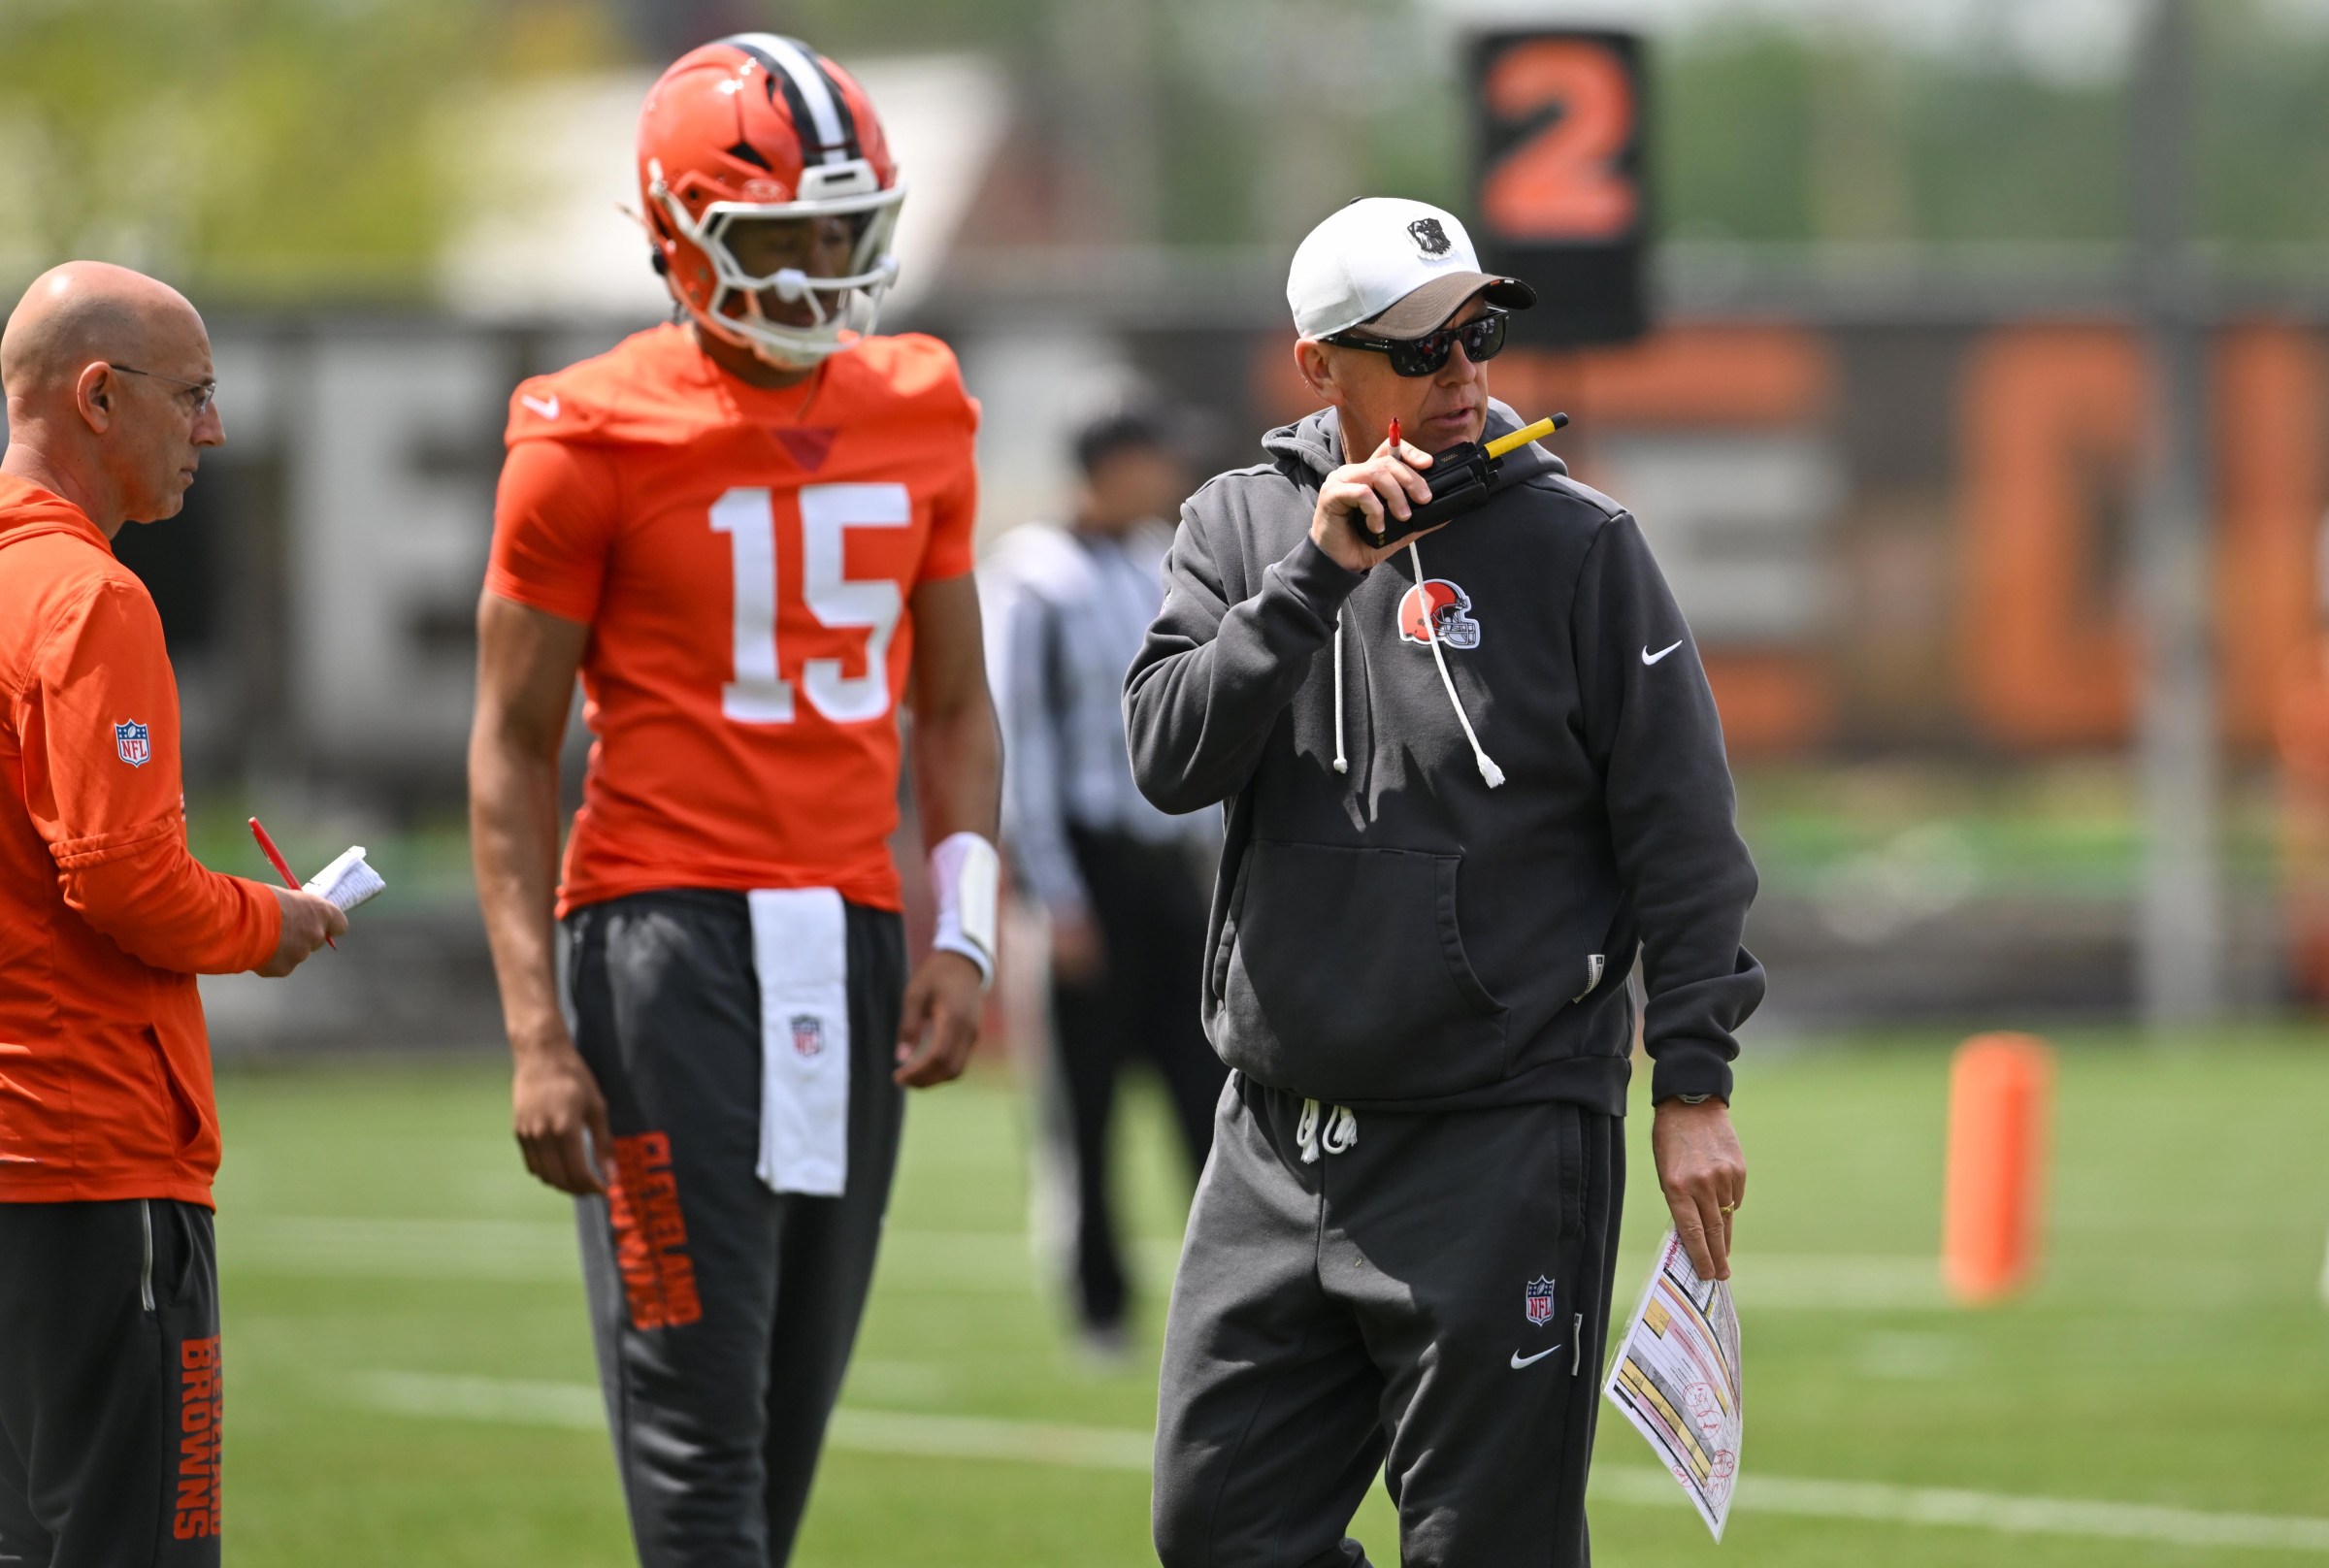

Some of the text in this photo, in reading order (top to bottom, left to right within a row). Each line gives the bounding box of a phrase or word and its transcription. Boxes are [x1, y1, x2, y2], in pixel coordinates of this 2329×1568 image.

[1481, 39, 1634, 241] 2
[708, 481, 912, 724] 15
[121, 739, 148, 761] NFL
[1528, 1297, 1552, 1320] NFL
[174, 1338, 213, 1540] BROWNS
